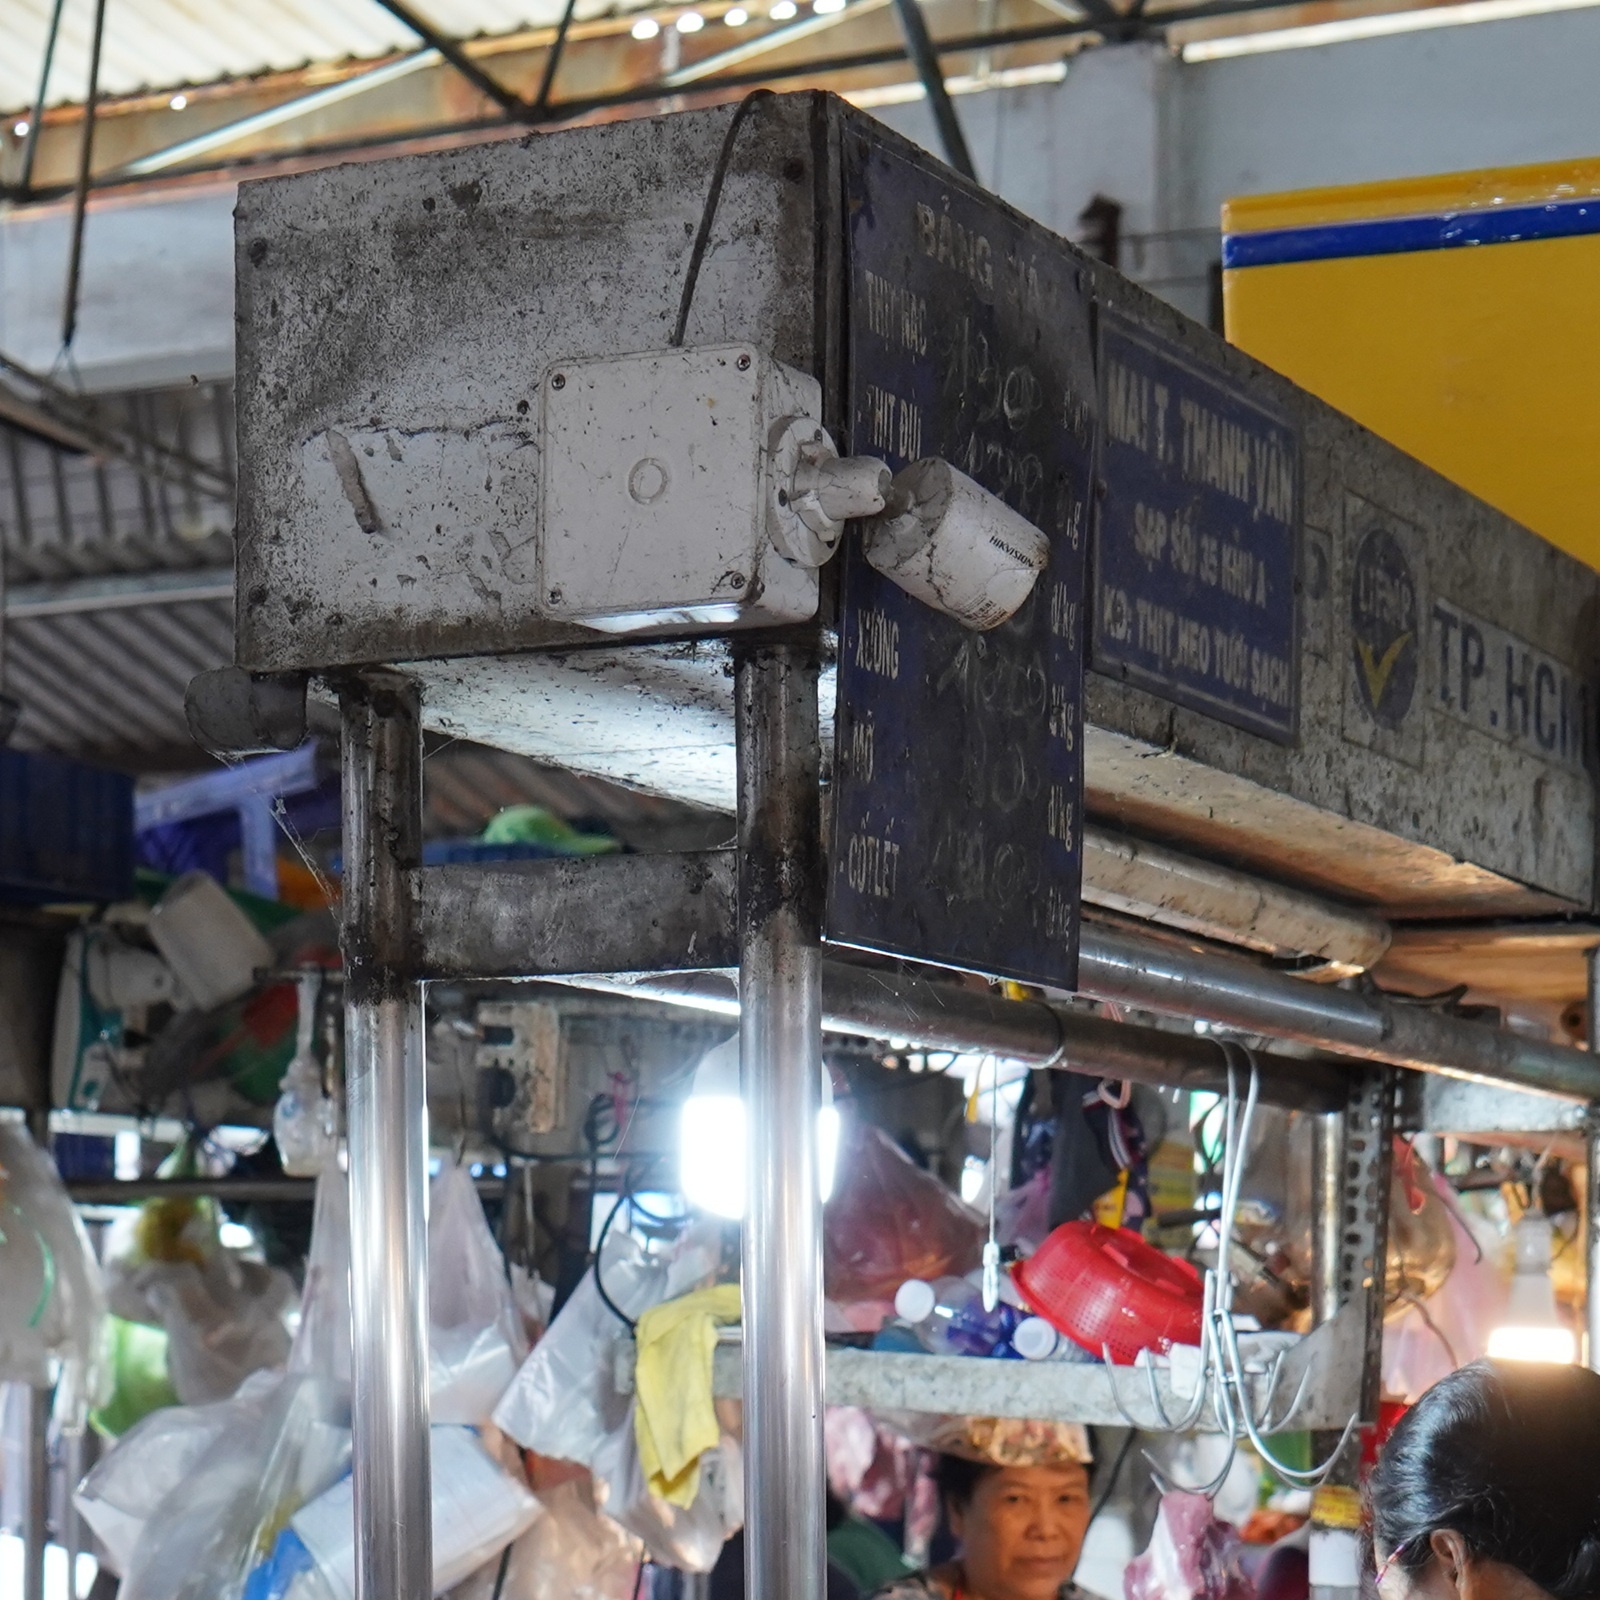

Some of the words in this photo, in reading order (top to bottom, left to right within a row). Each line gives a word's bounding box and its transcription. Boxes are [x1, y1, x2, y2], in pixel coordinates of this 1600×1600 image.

[1107, 361, 1148, 452] MAI
[1179, 397, 1249, 503] THANH
[988, 535, 1035, 568] HIKVISION
[1256, 559, 1267, 610] A
